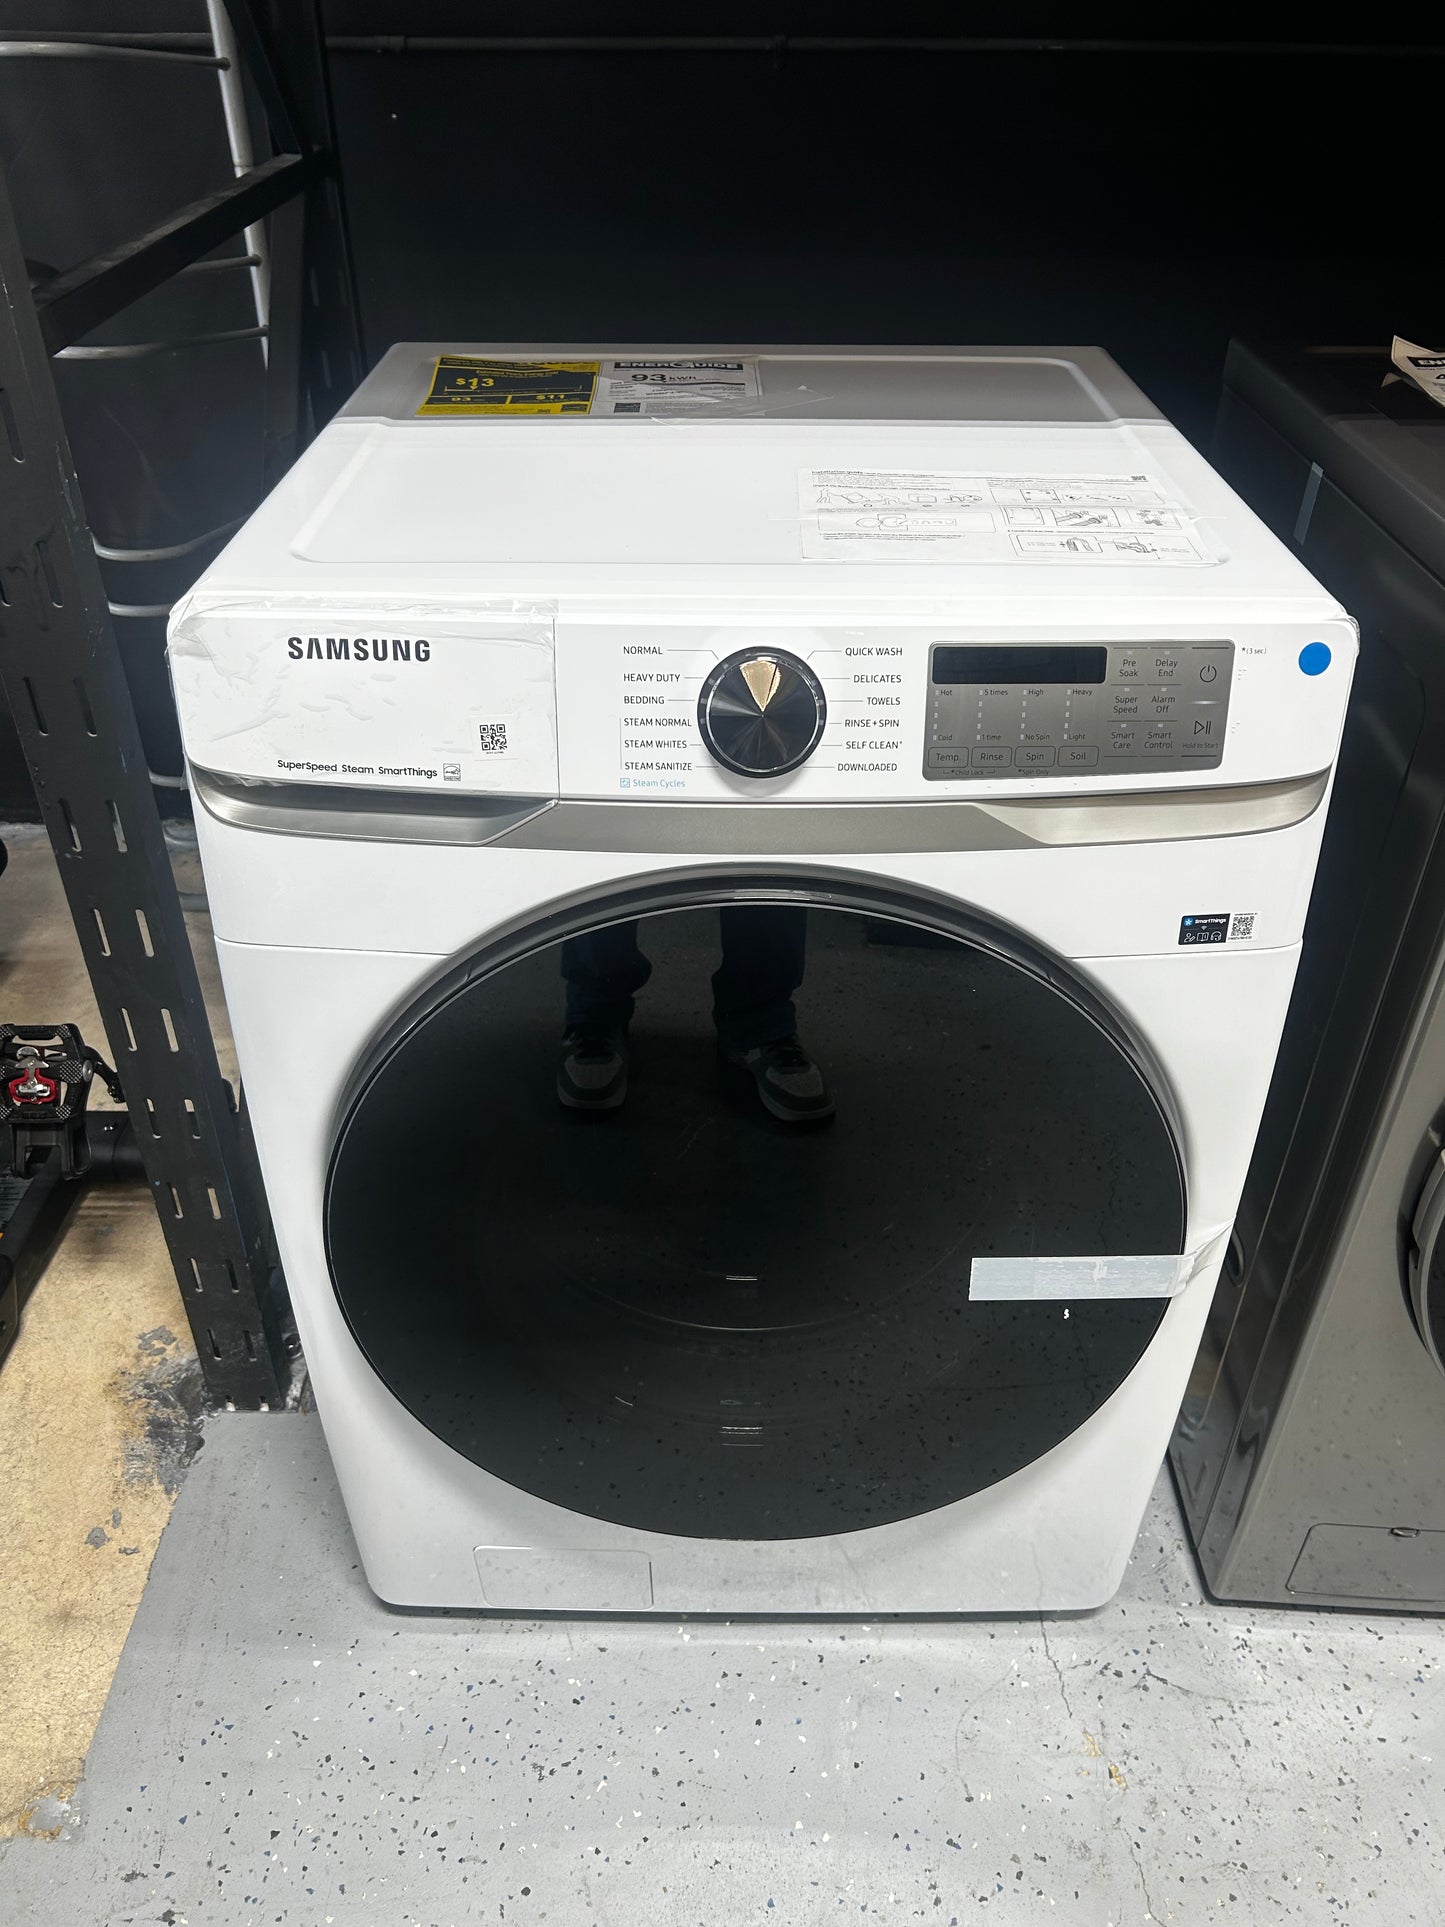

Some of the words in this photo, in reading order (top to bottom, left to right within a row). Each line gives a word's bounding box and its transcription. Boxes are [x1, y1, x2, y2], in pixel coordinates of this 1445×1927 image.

[631, 374, 666, 382] 93
[455, 378, 495, 388] $13
[287, 636, 430, 662] SAMSUNG
[623, 646, 663, 654] NORMAL
[845, 647, 874, 656] QUICK
[875, 647, 903, 656] WASH
[1155, 659, 1178, 668] Delay
[623, 674, 654, 682] HEAVY
[656, 674, 681, 682] DUTY
[853, 674, 902, 683] DELICATES
[624, 696, 665, 704] BEDDING
[867, 697, 901, 706] TOWELS
[1115, 696, 1138, 704] Super
[1113, 706, 1138, 714] Speed
[624, 718, 653, 726] STEAM
[655, 718, 692, 726] NORMAL
[844, 719, 871, 727] RINSE
[878, 719, 900, 727] SPIN
[624, 740, 653, 748] STEAM
[656, 740, 687, 748] WHITES
[845, 741, 867, 749] SELF
[1026, 752, 1044, 762] Spin
[1070, 752, 1086, 760] Soil
[277, 759, 338, 773] SuperSpeed
[341, 764, 374, 775] Steam
[378, 766, 438, 779] SmartThings
[625, 762, 654, 770] STEAM
[655, 762, 692, 770] SANITIZE
[837, 763, 898, 771] DOWNLOADED
[1036, 769, 1049, 777] Only
[660, 779, 685, 788] Cycles
